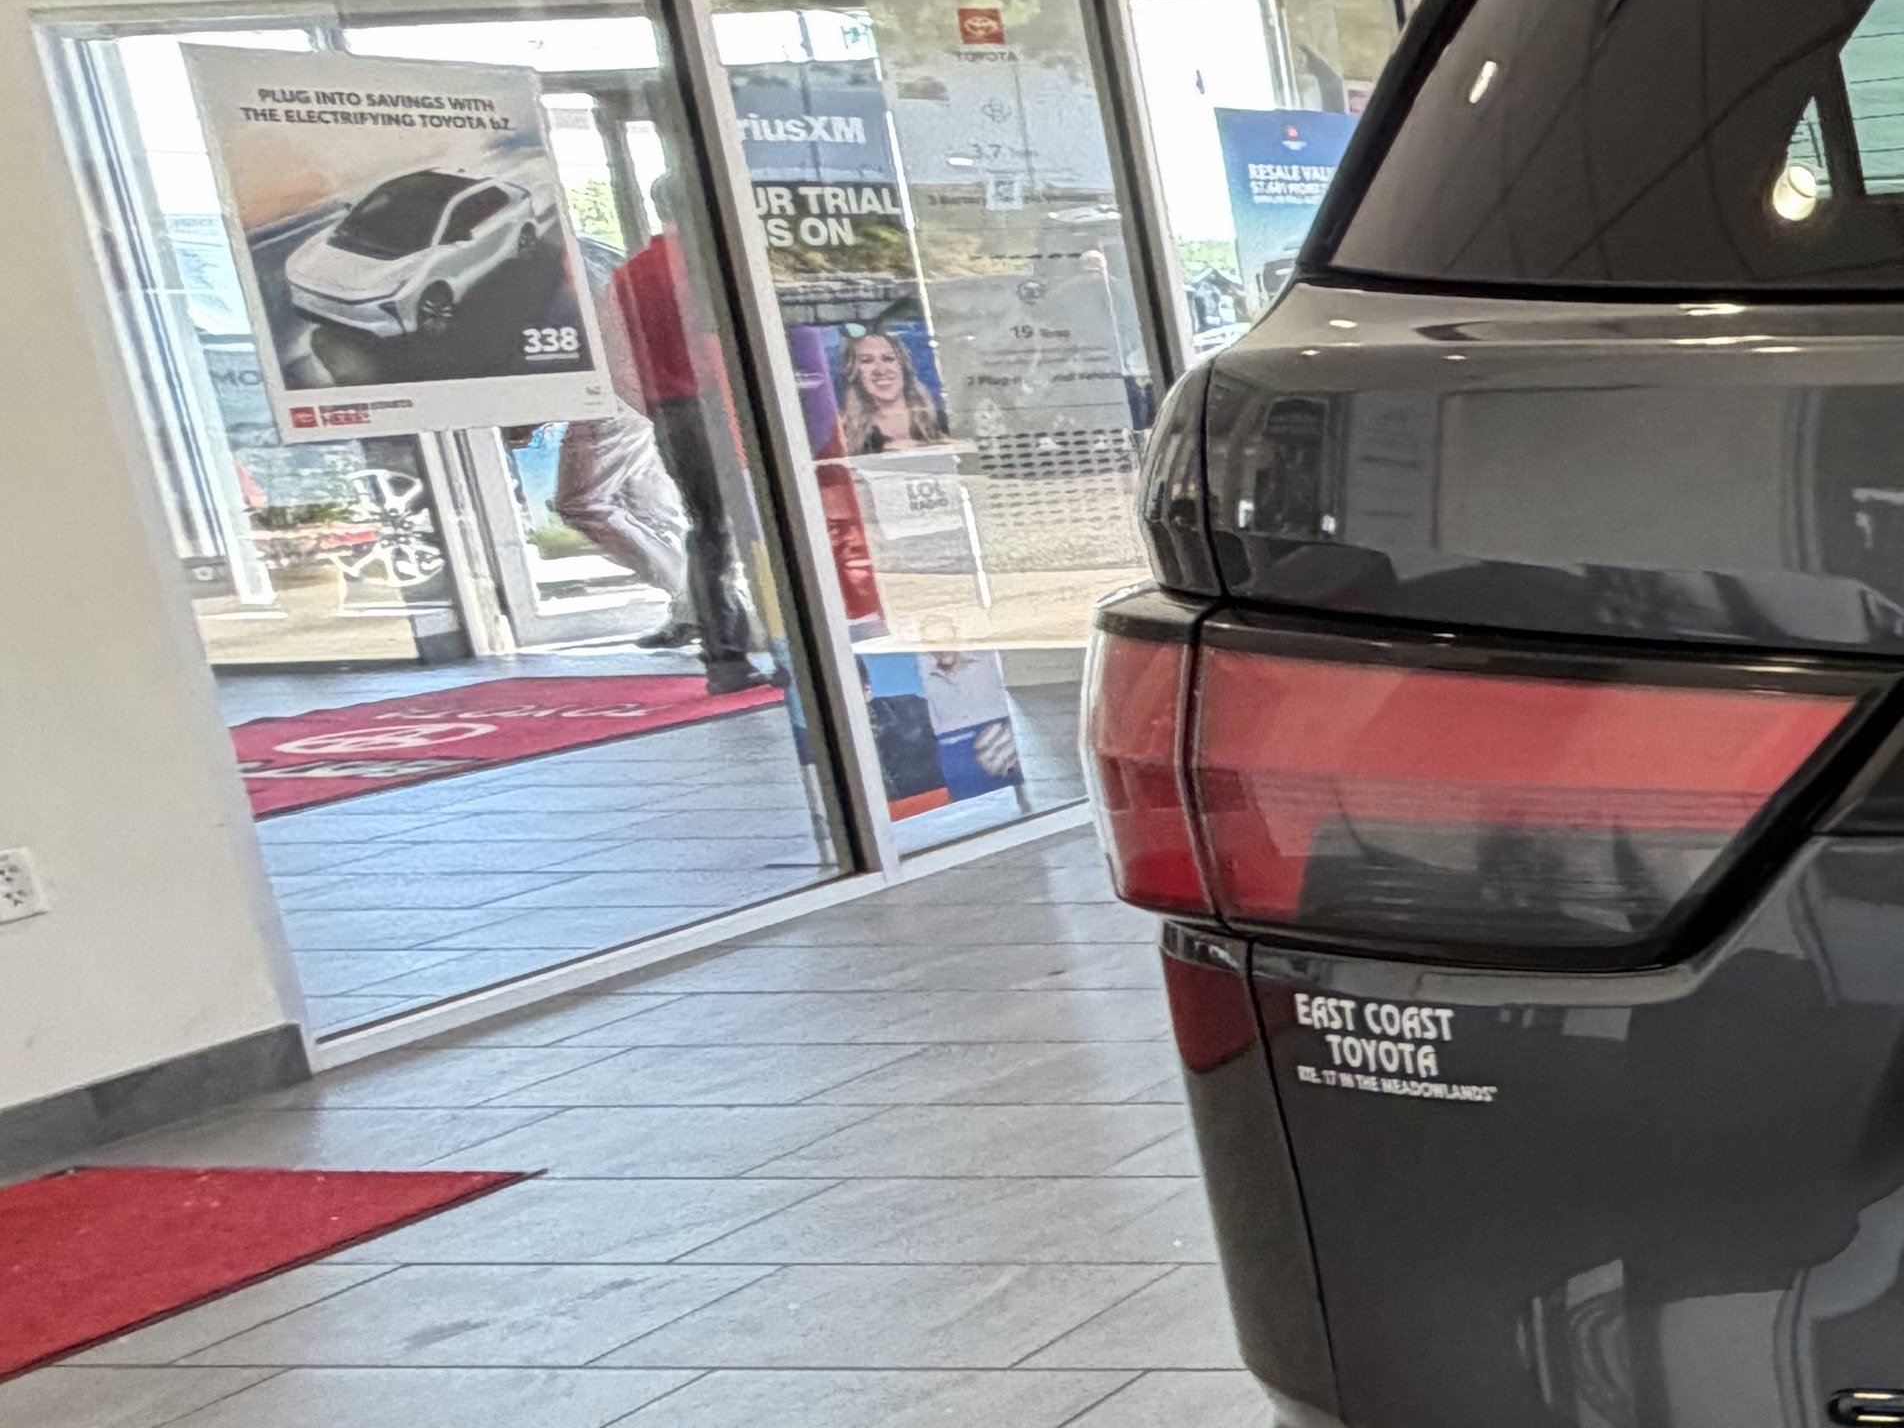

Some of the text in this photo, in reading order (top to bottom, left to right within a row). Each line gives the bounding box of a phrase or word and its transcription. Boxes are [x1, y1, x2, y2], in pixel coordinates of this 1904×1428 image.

[257, 88, 495, 112] PLUG INTO SAVINGS WITH
[240, 107, 281, 123] THE
[285, 109, 416, 127] ELECTRIFYING
[419, 113, 488, 130] TOYOTA
[737, 113, 866, 144] riusXM
[752, 186, 797, 216] UR
[798, 186, 902, 215] TRIAL
[799, 217, 857, 247] ON
[522, 326, 580, 354] 338
[1294, 992, 1455, 1042] EAST COAST
[1325, 1034, 1440, 1078] TOYOTA
